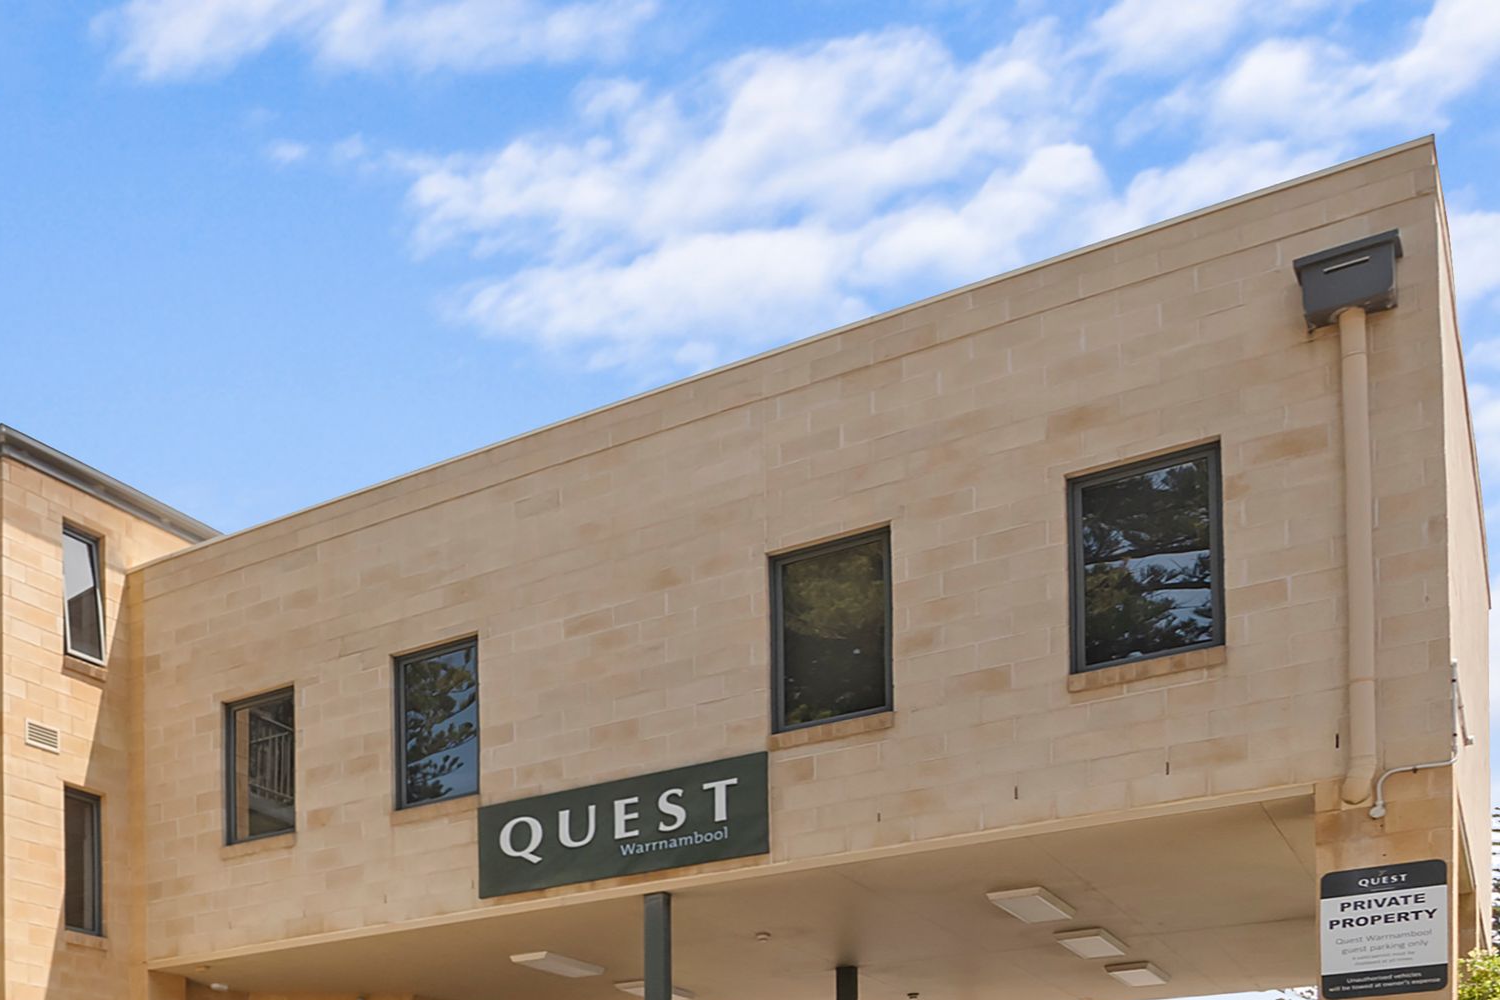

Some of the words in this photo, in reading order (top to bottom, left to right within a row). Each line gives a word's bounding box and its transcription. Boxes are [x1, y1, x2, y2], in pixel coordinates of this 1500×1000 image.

[499, 777, 739, 864] QUEST
[620, 826, 728, 856] Warrnambool
[1358, 873, 1408, 887] QUEST
[1340, 893, 1426, 912] PRIVATE
[1329, 908, 1438, 930] PROPERTY
[1370, 941, 1406, 952] parking
[1408, 939, 1428, 948] only
